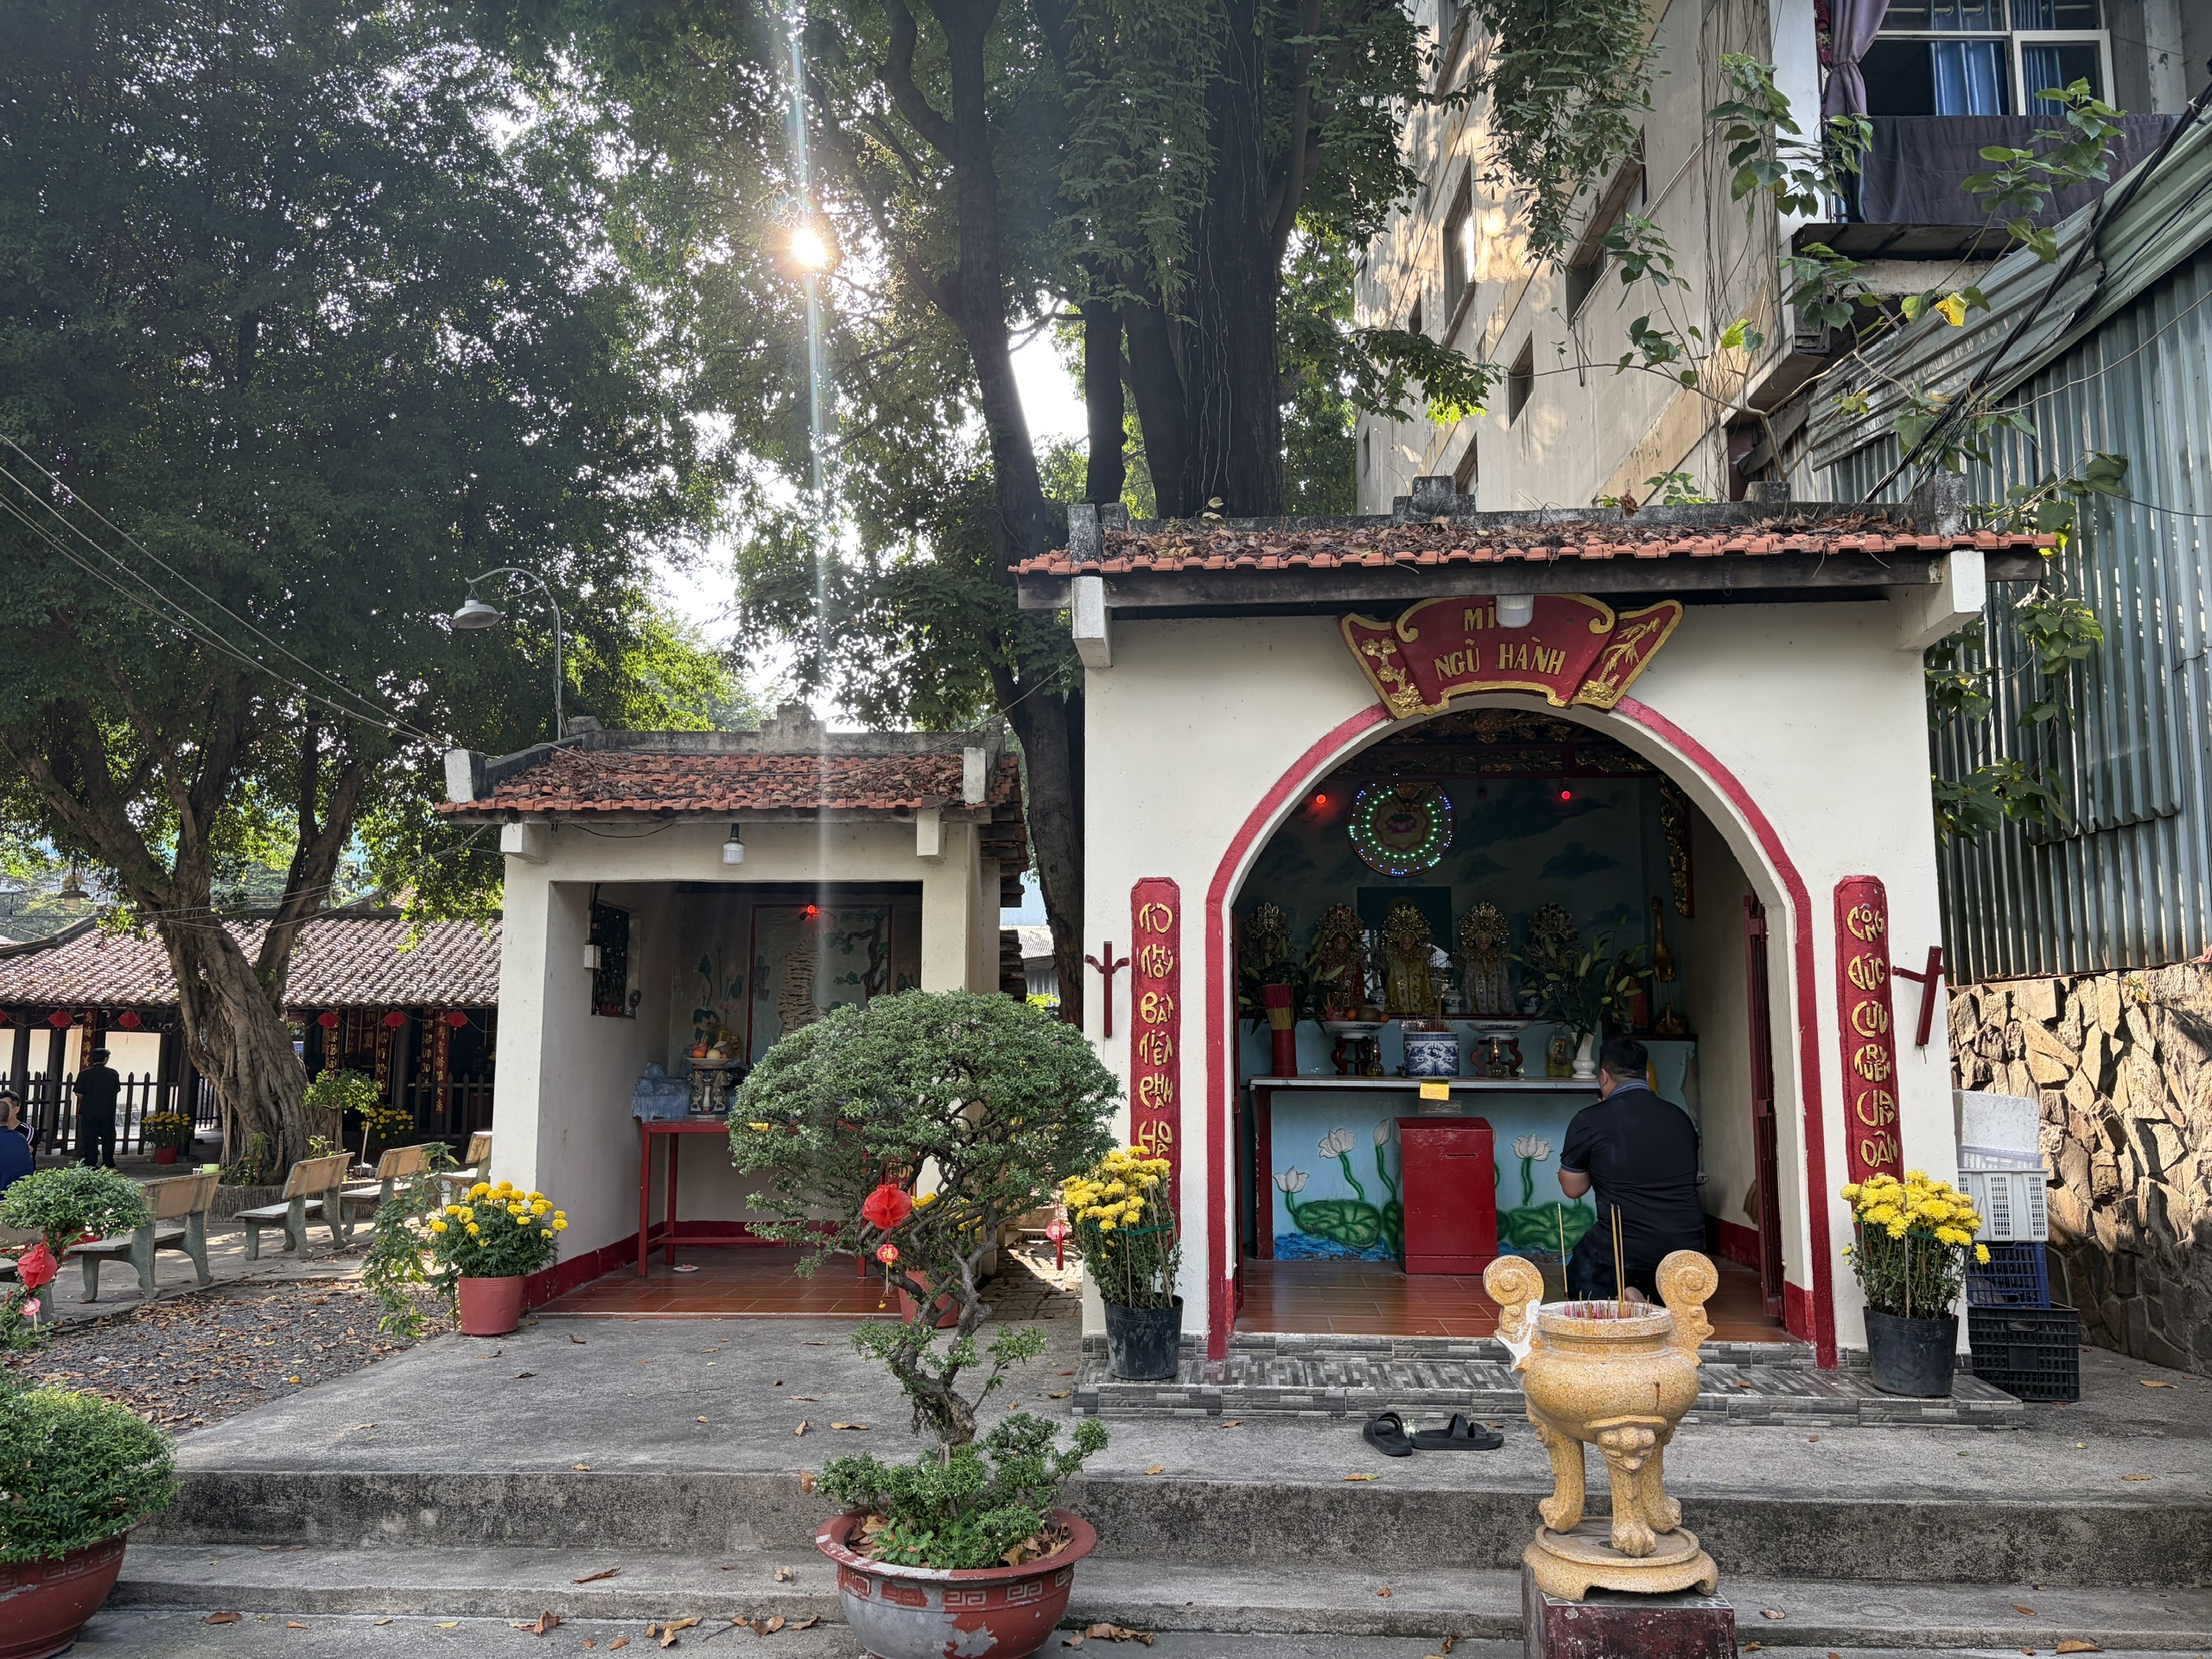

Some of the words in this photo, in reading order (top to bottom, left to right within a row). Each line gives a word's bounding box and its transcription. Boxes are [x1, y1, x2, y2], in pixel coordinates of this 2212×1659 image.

[1433, 638, 1480, 682] NGŨ
[1498, 636, 1567, 676] HÀNH
[1847, 903, 1885, 942] CÔNG
[1847, 952, 1885, 990] ĐỨC
[1141, 991, 1174, 1026] BÁT
[1860, 1130, 1898, 1167] DÂN
[880, 1247, 894, 1259] 福
